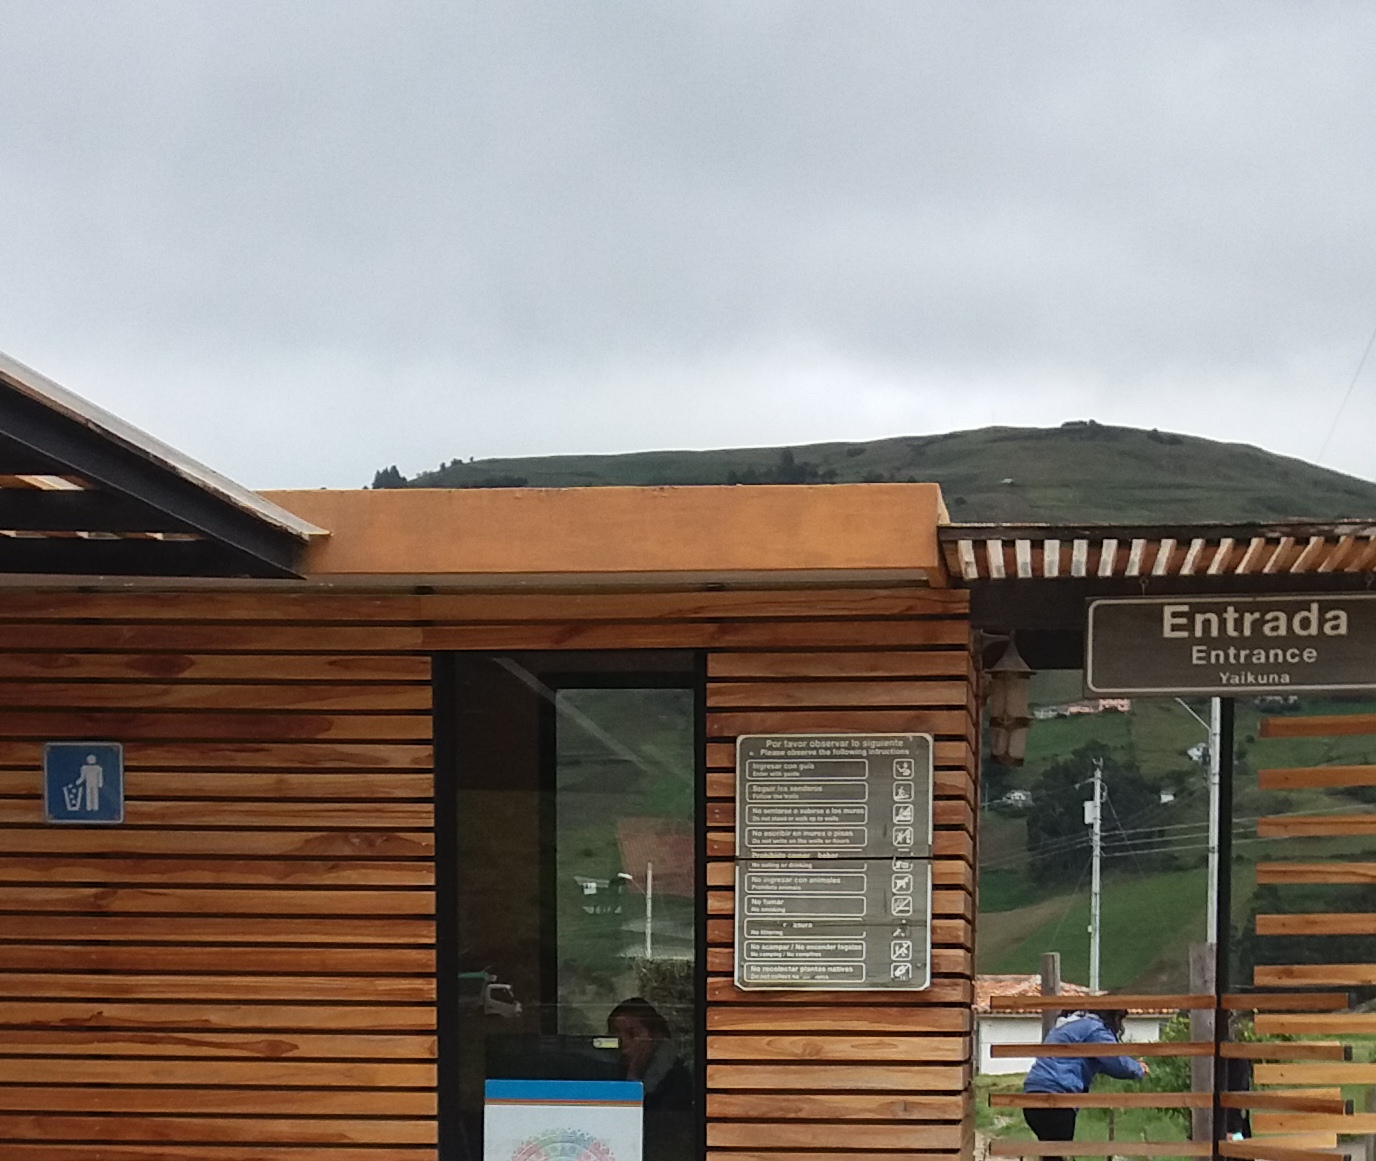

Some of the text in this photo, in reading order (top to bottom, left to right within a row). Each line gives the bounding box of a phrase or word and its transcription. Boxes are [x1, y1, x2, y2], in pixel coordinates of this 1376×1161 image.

[1163, 602, 1349, 638] Entrada
[1192, 645, 1318, 665] Entrance
[1220, 671, 1290, 684] Yaikuna
[766, 739, 904, 748] Por favor observar lo siguiente
